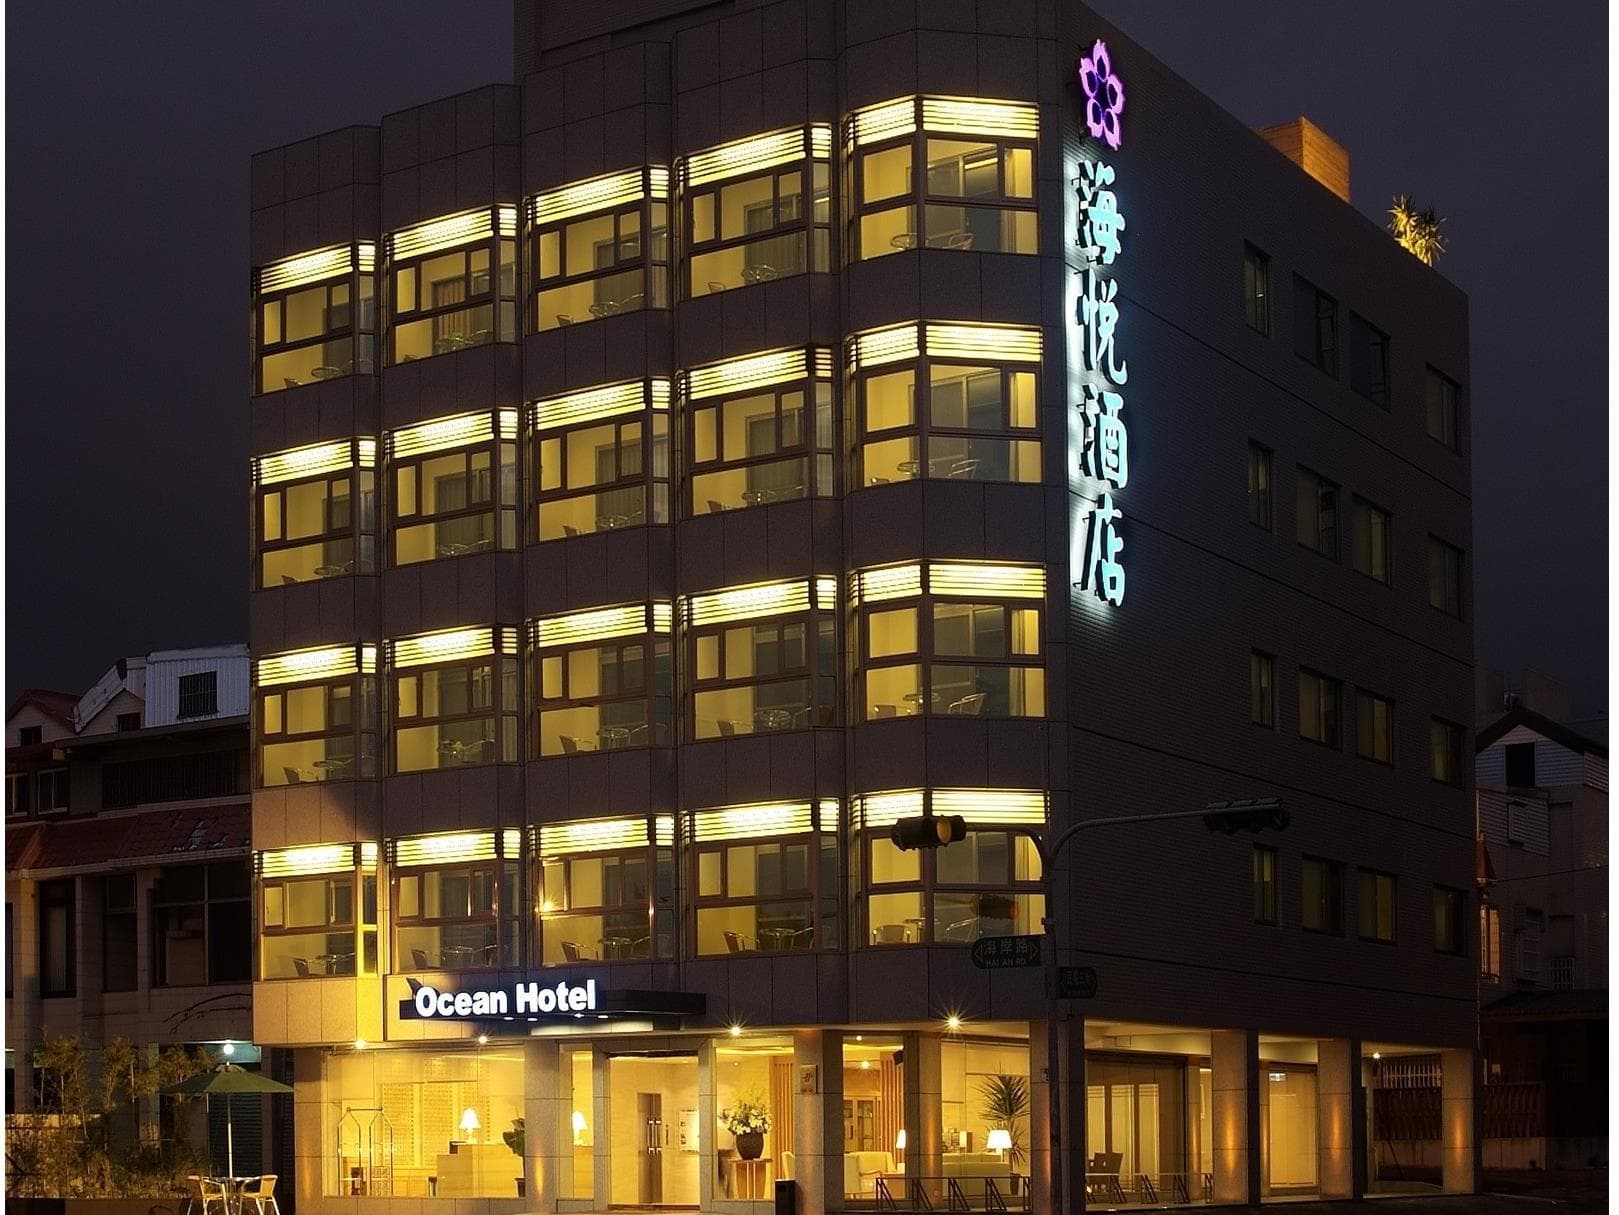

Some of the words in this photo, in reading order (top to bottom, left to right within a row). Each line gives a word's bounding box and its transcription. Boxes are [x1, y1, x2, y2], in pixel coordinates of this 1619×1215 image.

[984, 938, 1027, 955] 海岸路
[985, 958, 1000, 968] HAI
[1001, 958, 1014, 968] AN
[415, 986, 508, 1017] Ocean
[516, 979, 596, 1012] Hotel
